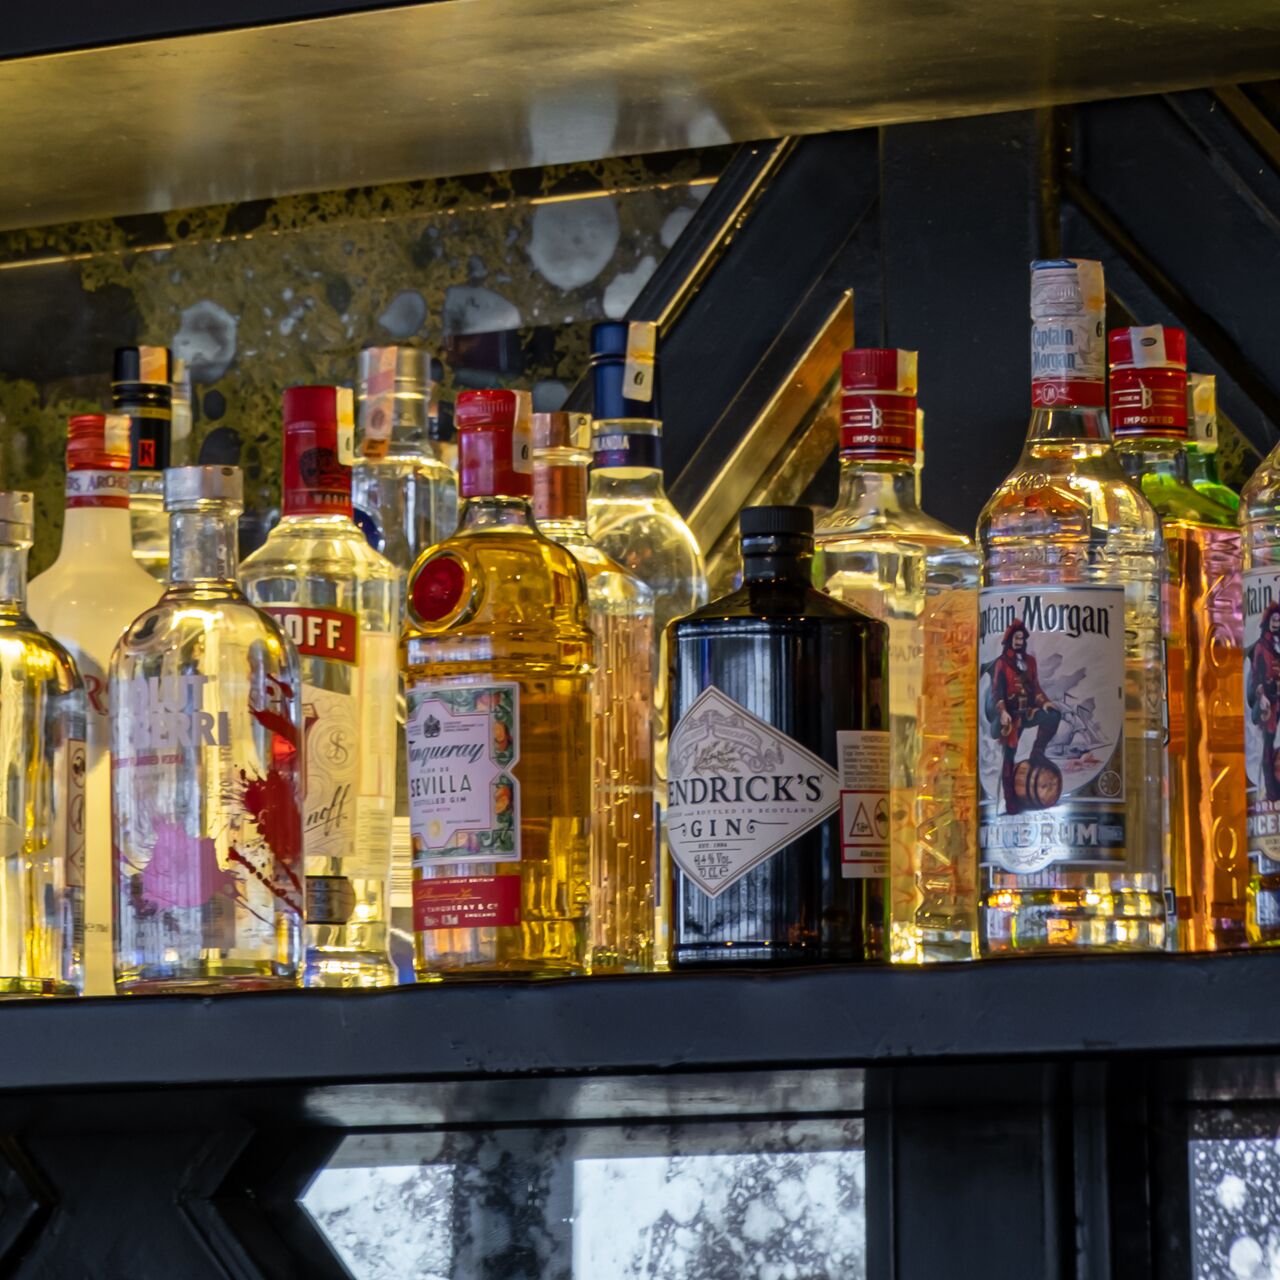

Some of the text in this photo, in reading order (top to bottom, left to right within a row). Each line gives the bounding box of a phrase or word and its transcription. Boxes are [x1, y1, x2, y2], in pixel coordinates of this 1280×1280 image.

[1032, 325, 1075, 351] Captain
[1032, 350, 1077, 372] Morgan
[1123, 415, 1175, 425] IMPORTED
[1017, 594, 1111, 639] Morgan
[410, 774, 473, 798] SEVILLA
[305, 782, 352, 837] noff
[690, 817, 744, 839] GIN
[1040, 822, 1099, 847] RUM
